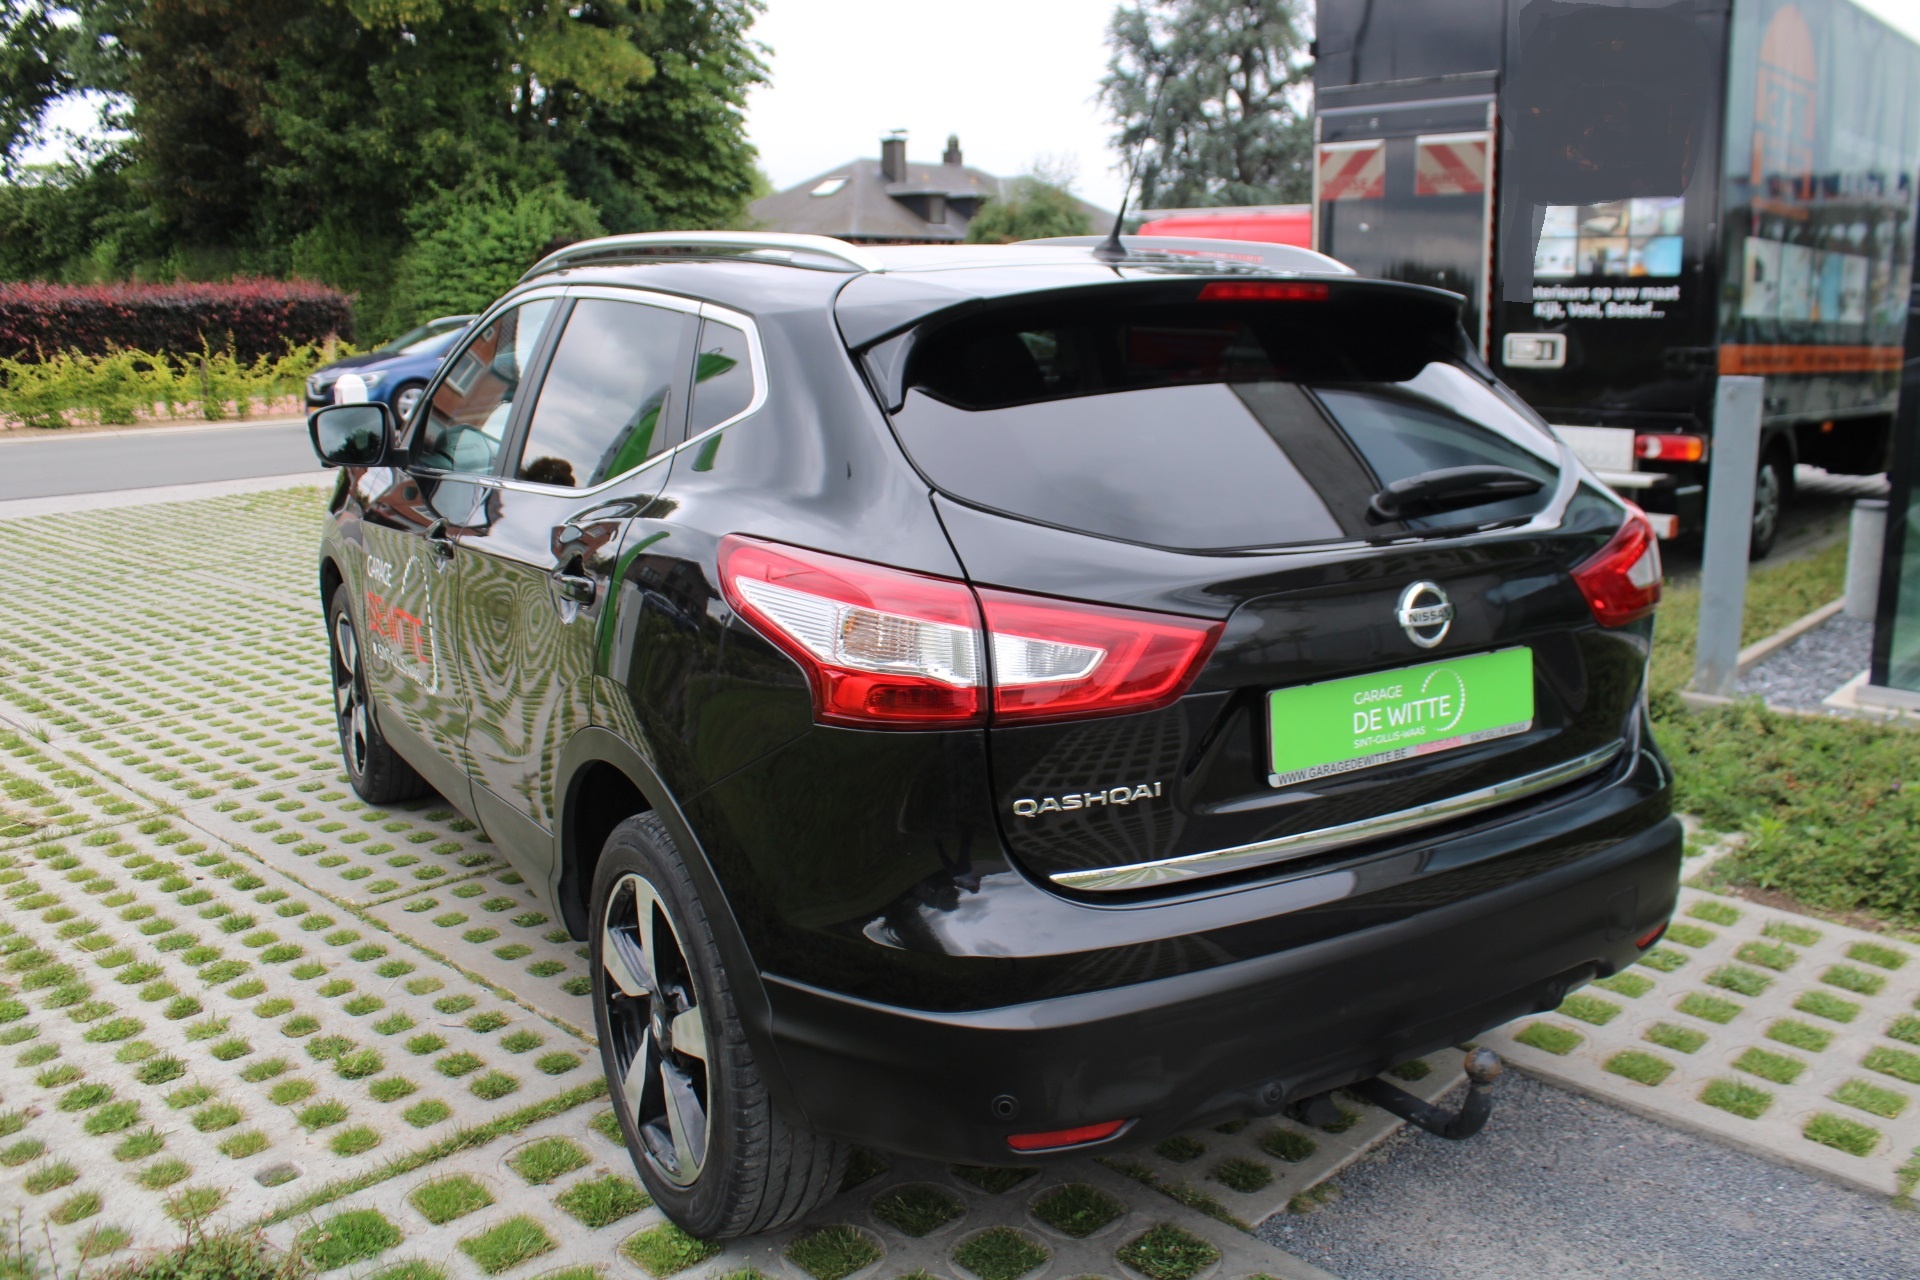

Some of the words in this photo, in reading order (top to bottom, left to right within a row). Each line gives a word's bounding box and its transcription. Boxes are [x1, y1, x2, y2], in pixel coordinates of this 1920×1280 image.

[1533, 285, 1590, 300] nterieurs
[1590, 287, 1612, 303] op
[1613, 287, 1639, 300] uw
[1639, 285, 1680, 301] maat
[367, 555, 393, 588] GARAGE
[1408, 607, 1451, 623] NISSAN
[1353, 684, 1403, 705] GARAGE
[1353, 708, 1383, 734] DE
[1386, 694, 1452, 727] WITTE
[1353, 725, 1427, 749] SINT-GILLIS-WAAS
[1278, 747, 1407, 785] WWW.GARAGEDEWITTE.BE
[1012, 781, 1162, 818] QASHQAI
